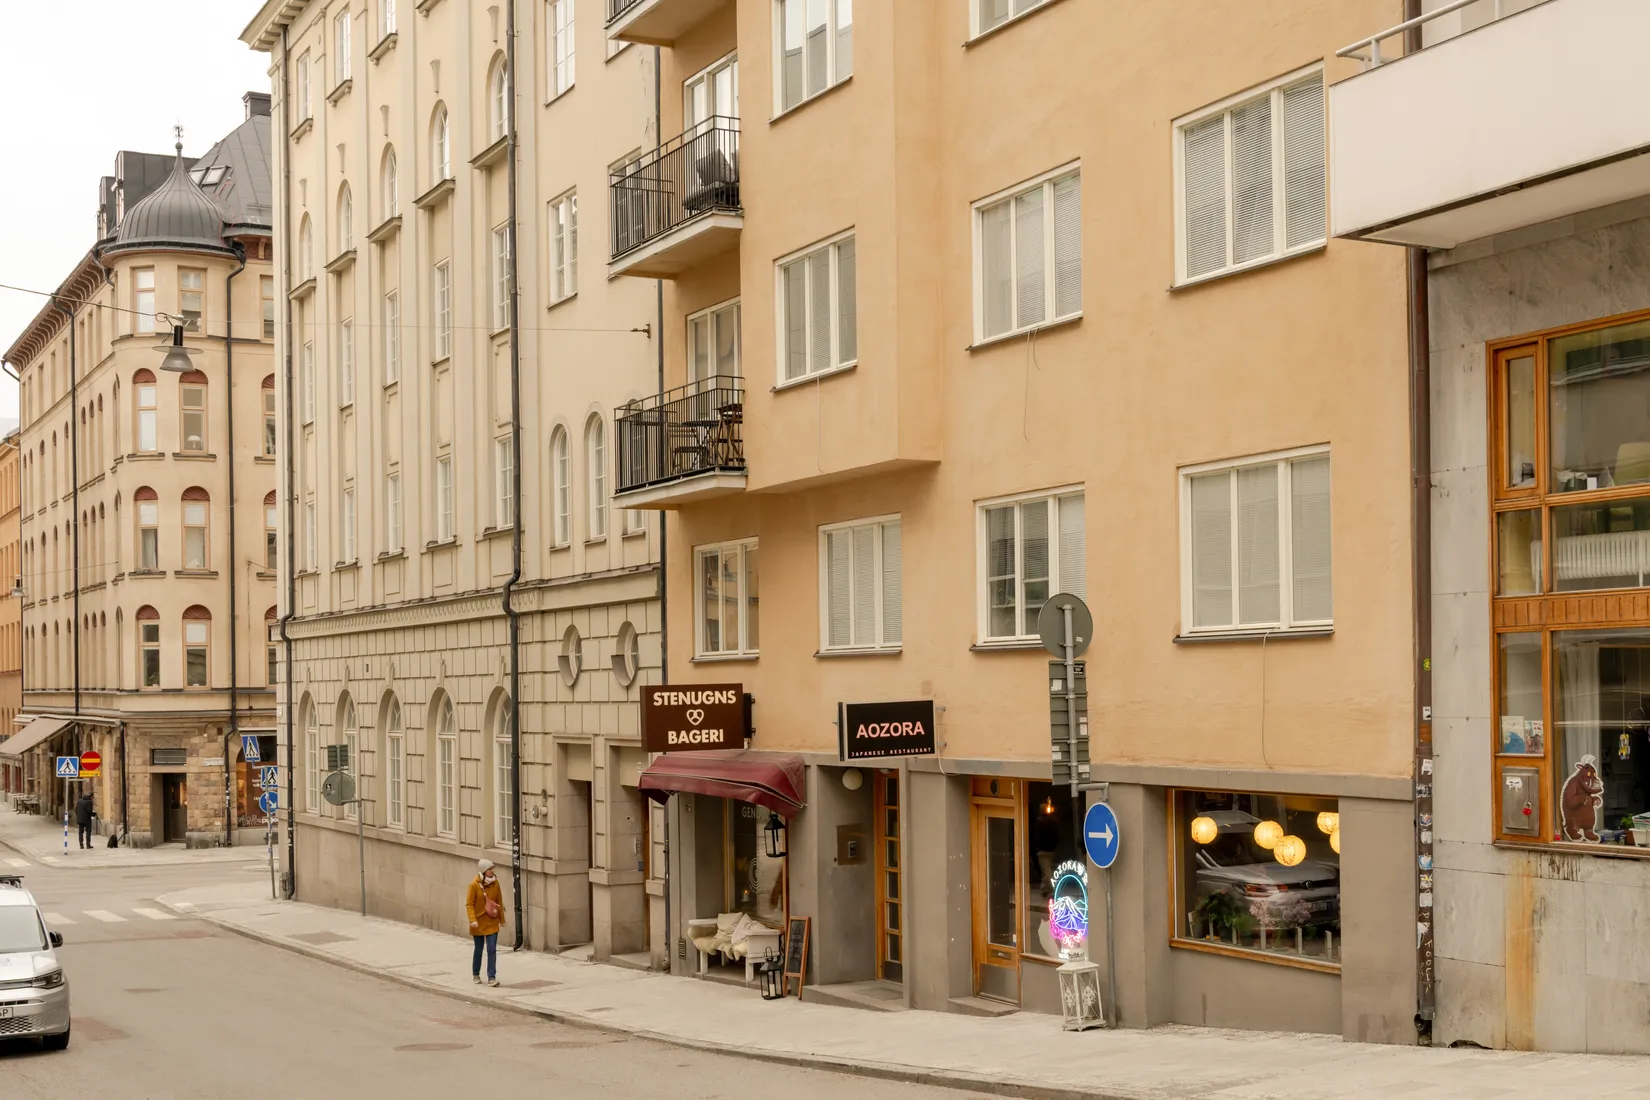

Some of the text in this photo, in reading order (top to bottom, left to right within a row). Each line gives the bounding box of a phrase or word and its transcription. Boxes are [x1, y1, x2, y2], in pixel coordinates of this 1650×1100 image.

[653, 690, 736, 706] STENUGNS
[667, 729, 724, 745] BAGERI
[856, 721, 925, 739] AOZORA
[851, 747, 931, 757] JAPANESE RESTAURANT
